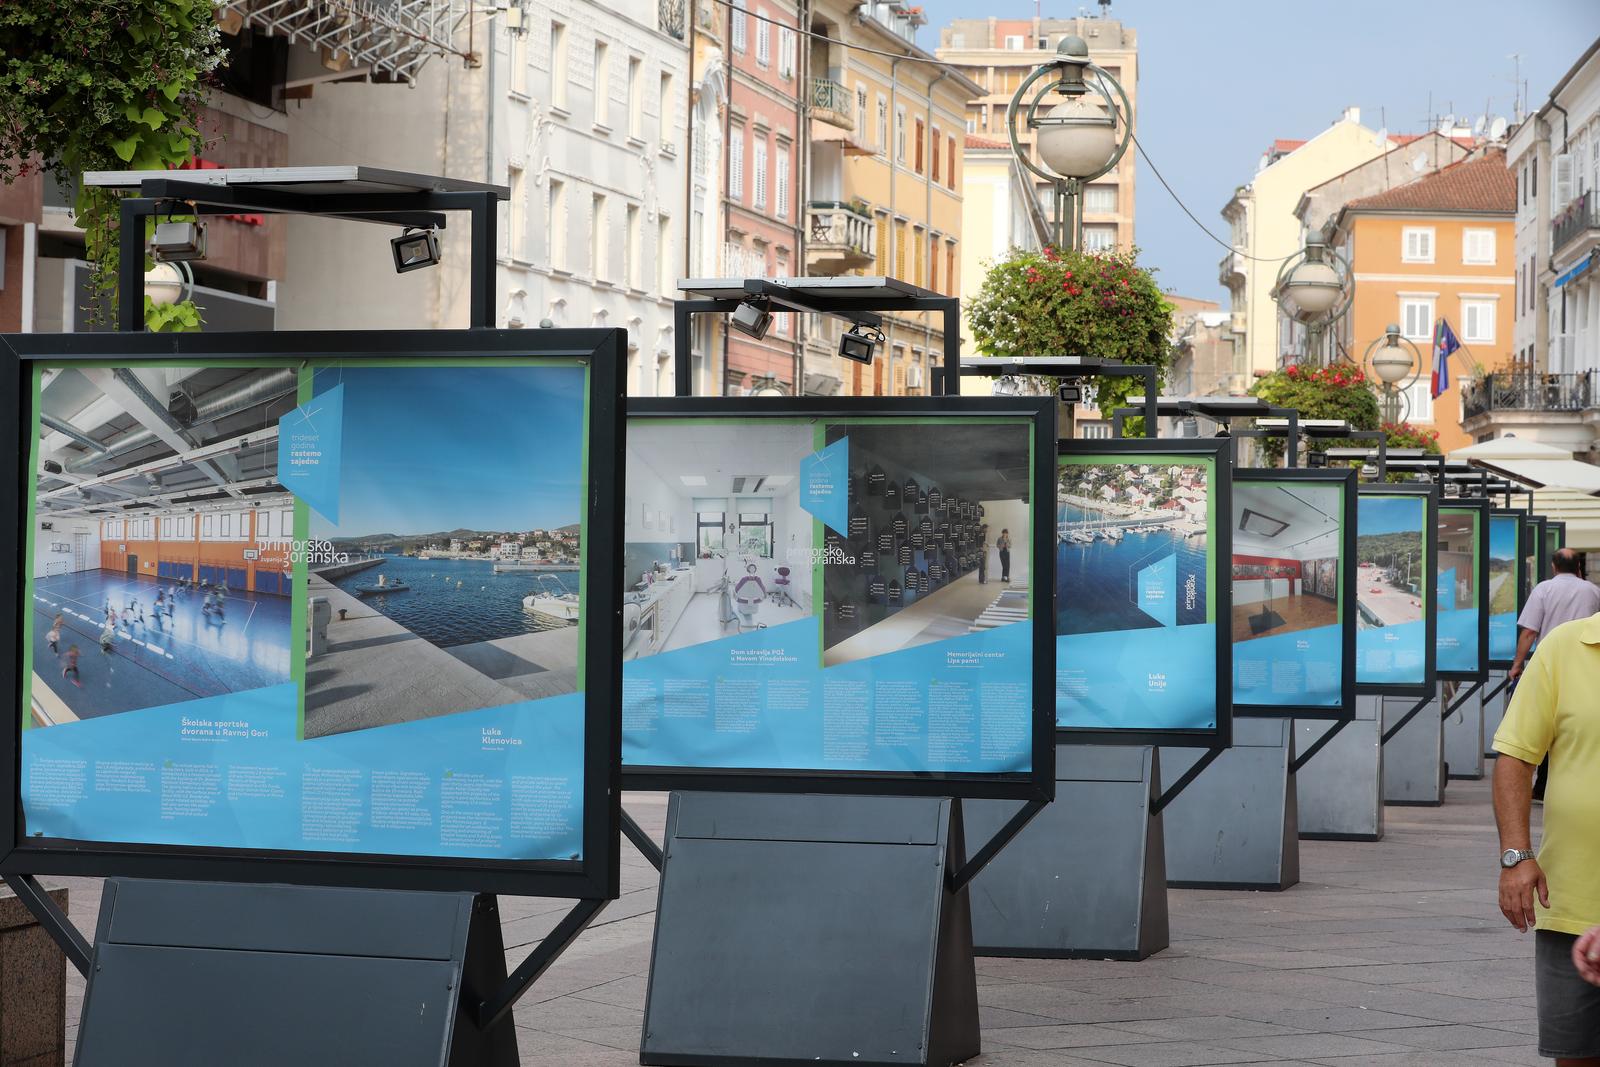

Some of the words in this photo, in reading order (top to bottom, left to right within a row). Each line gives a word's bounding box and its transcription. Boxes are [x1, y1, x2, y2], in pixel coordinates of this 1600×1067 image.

[258, 536, 332, 555] primorsko
[283, 546, 349, 567] goranska
[182, 716, 213, 727] Školska
[214, 719, 249, 729] sportska
[181, 728, 214, 736] dvorana
[222, 728, 249, 739] Ravnoj
[250, 729, 268, 737] Gori
[482, 728, 502, 736] Luka
[482, 736, 522, 745] Klenovica
